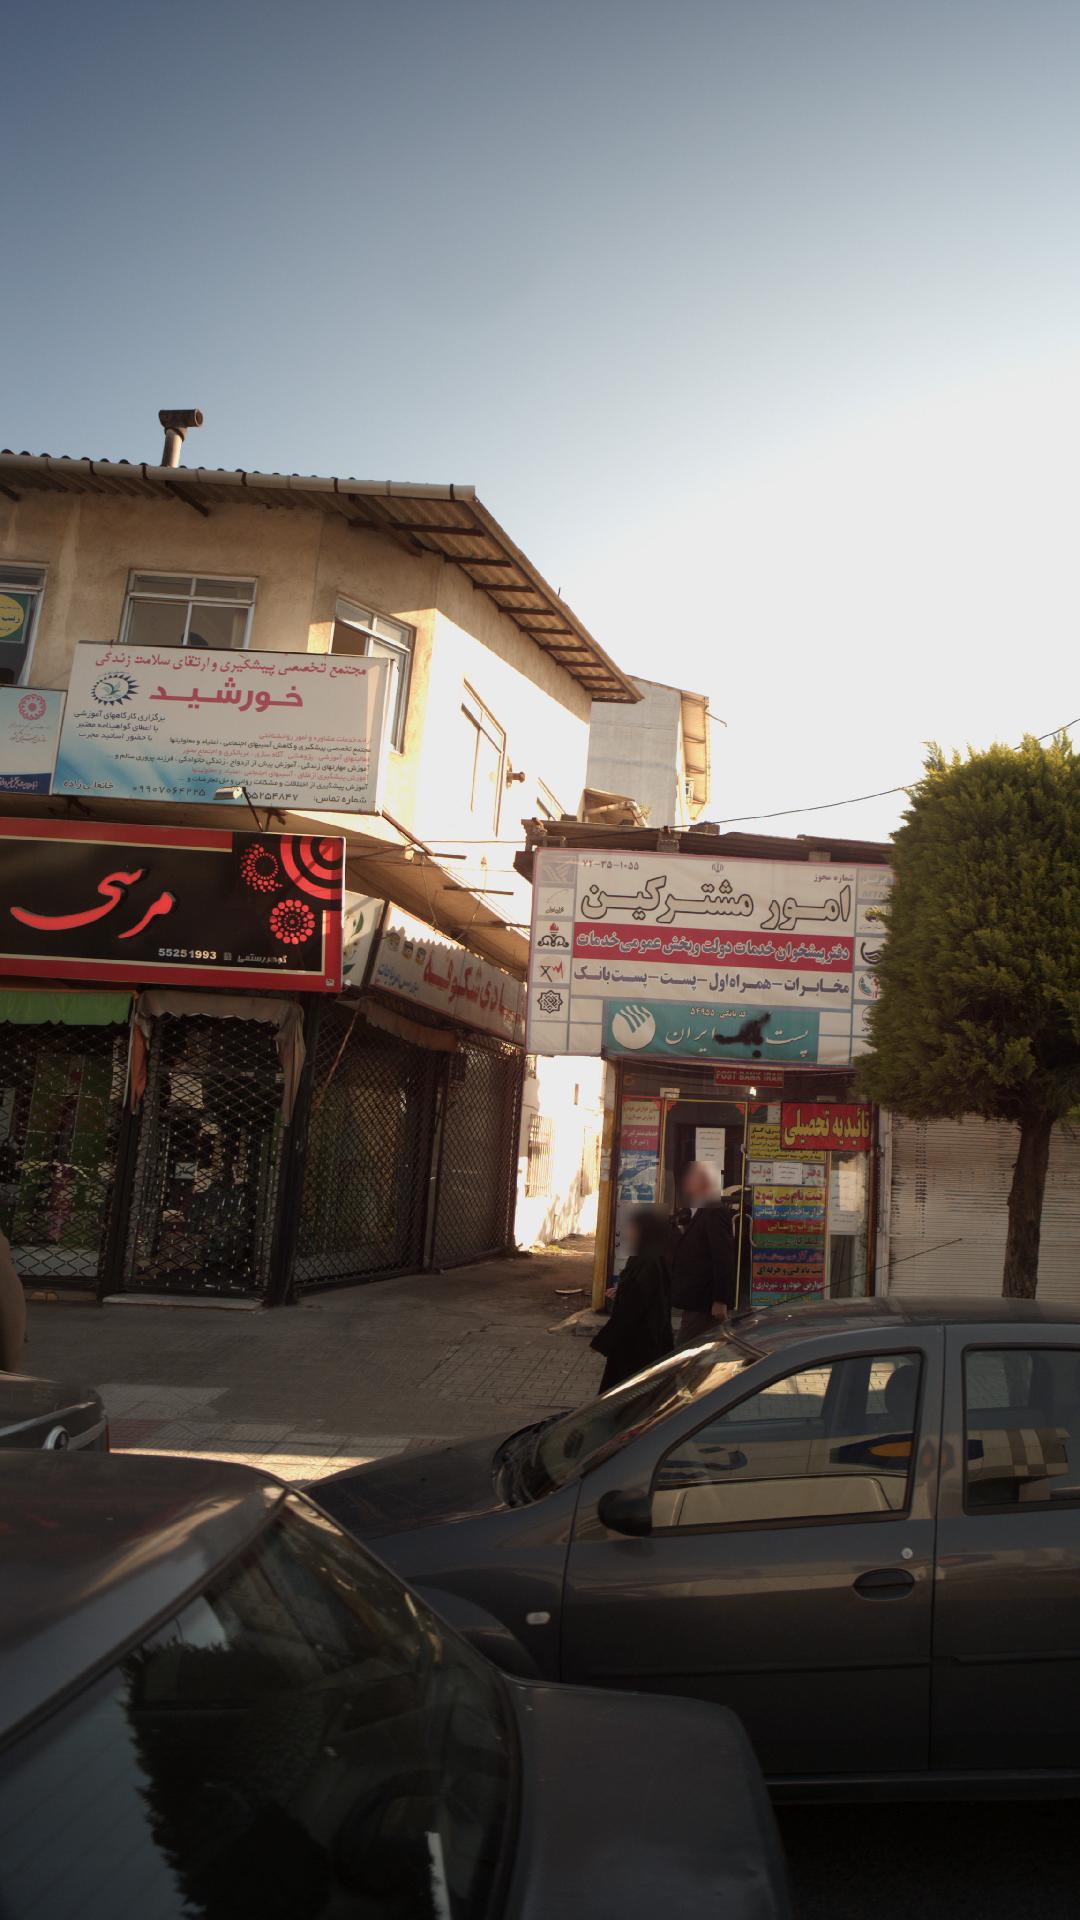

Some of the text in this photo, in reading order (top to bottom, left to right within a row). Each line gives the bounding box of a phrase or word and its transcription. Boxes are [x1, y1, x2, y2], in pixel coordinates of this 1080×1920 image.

[95, 652, 131, 668] زندگی
[134, 655, 171, 667] سلامت
[172, 656, 210, 671] ارتقای
[219, 654, 276, 676] پیشگیری
[278, 662, 327, 676] تخصصی
[329, 664, 367, 678] مجتمع
[149, 677, 304, 713] خورشید
[73, 709, 102, 720] آموزشی
[138, 712, 166, 723] برگزاری
[342, 795, 368, 805] شماره
[581, 874, 851, 931] امور مشترکین
[576, 929, 621, 949] خدمات
[619, 936, 662, 954] عمومی
[661, 936, 693, 956] بخش
[701, 936, 733, 959] دولت
[734, 939, 776, 957] خدمات
[158, 948, 217, 960] 55251993
[775, 941, 827, 964] پیشخوان
[826, 943, 850, 965] دفتر
[574, 965, 849, 997] مخابرات همراه اول پست پست بانک
[766, 1028, 810, 1058] پست
[716, 1070, 784, 1083] POST BANK IRAN
[784, 1107, 830, 1146] تحصیلی
